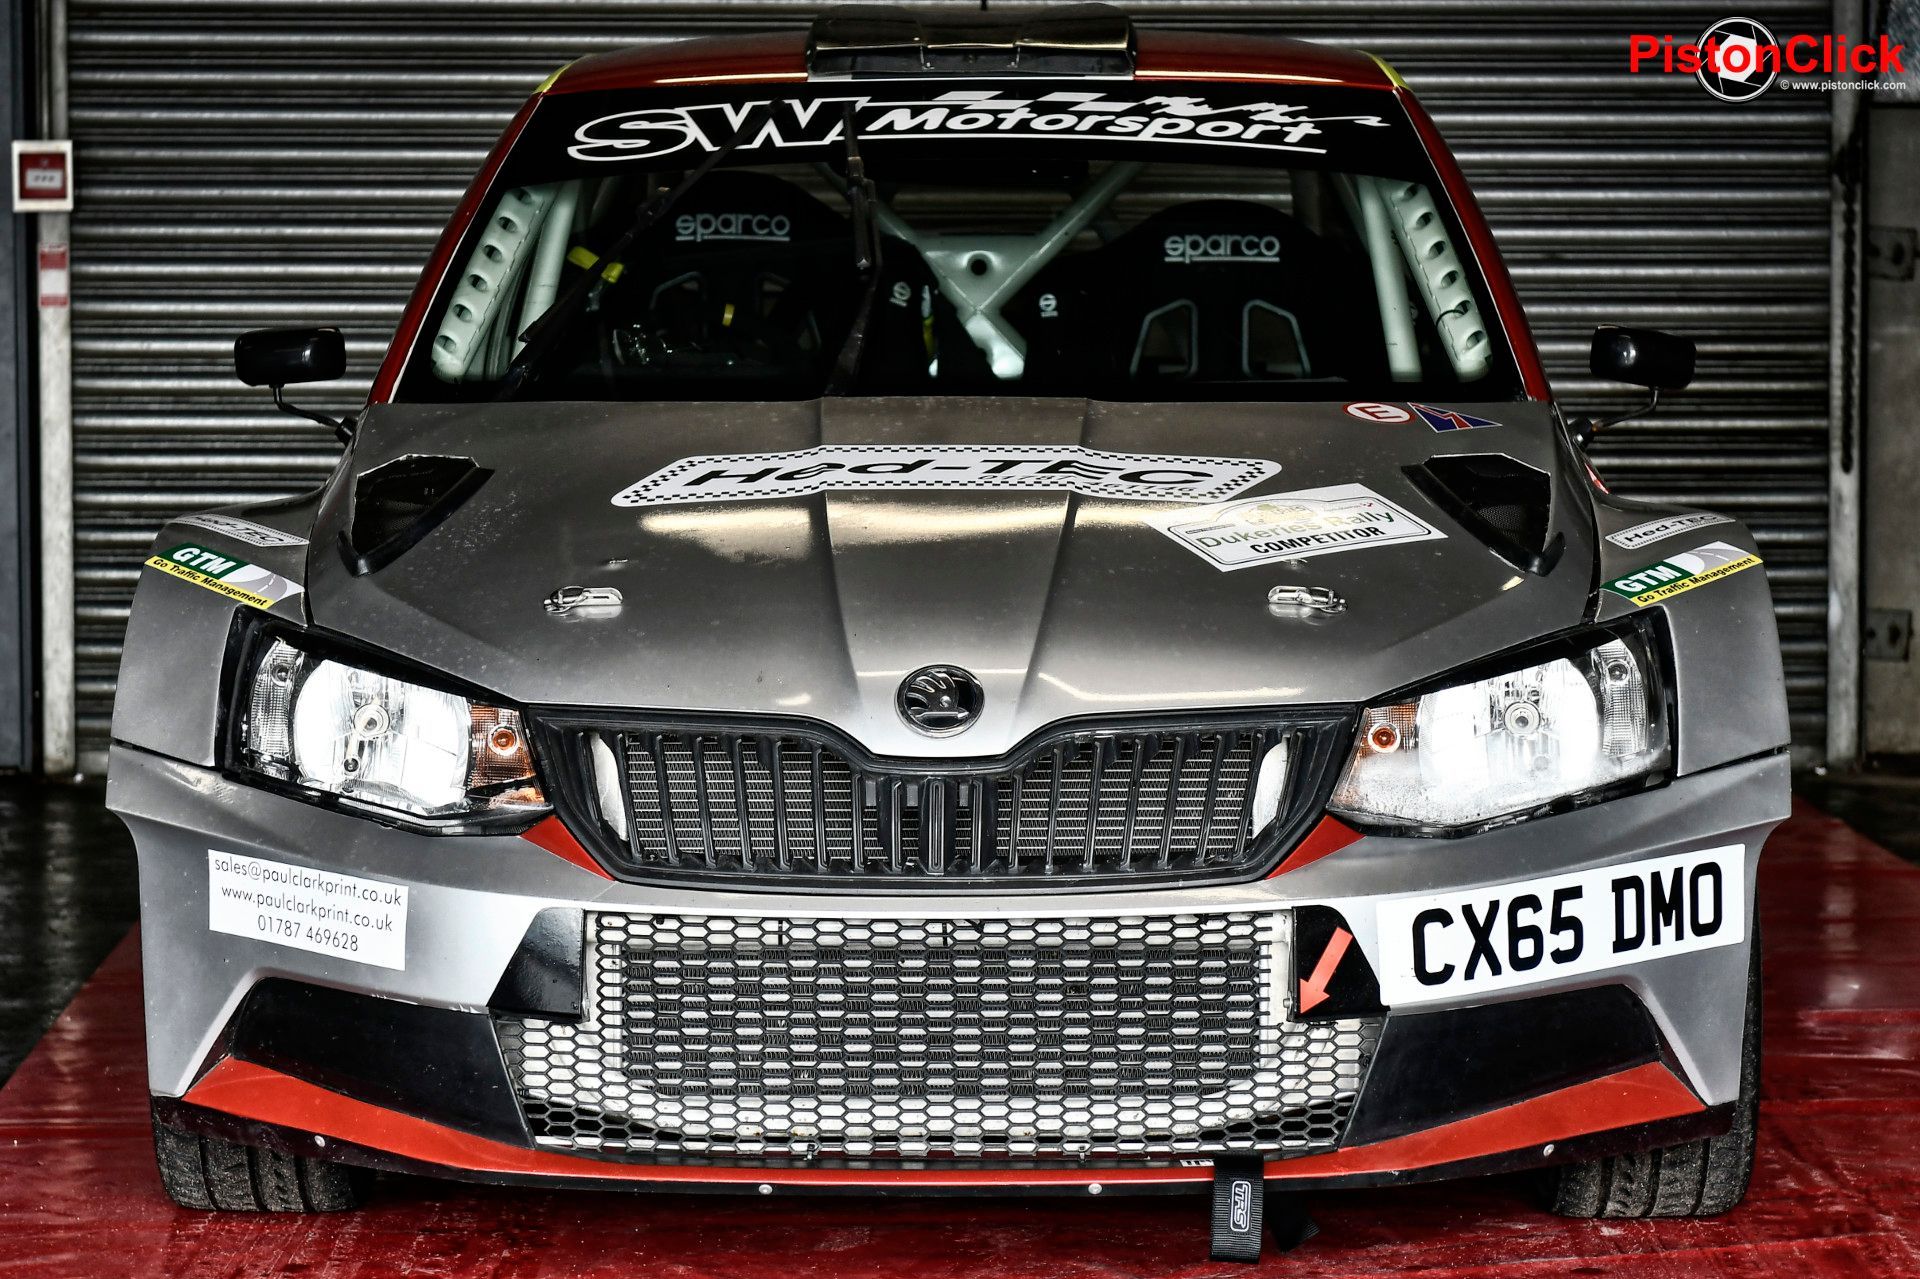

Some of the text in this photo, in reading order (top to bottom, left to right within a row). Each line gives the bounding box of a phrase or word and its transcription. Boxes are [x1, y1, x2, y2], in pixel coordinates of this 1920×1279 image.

[866, 107, 1323, 143] Motorsport
[676, 212, 790, 242] sparco
[1165, 231, 1281, 264] sparco
[1356, 405, 1399, 420] E
[1196, 522, 1322, 548] Dukeries
[1323, 511, 1395, 527] Rally
[1250, 526, 1387, 553] COMPETITOR
[172, 547, 237, 575] GTM
[1615, 565, 1683, 592] GTM
[153, 558, 268, 607] Go Traffic Management
[1637, 557, 1755, 603] Go Traffic Management
[214, 856, 402, 906] sales@paulclarkprint.co.uk
[221, 886, 393, 932] www.paulclarkprint.co.uk
[1411, 861, 1723, 986] CX65 DMO
[257, 914, 359, 952] 01787 469628
